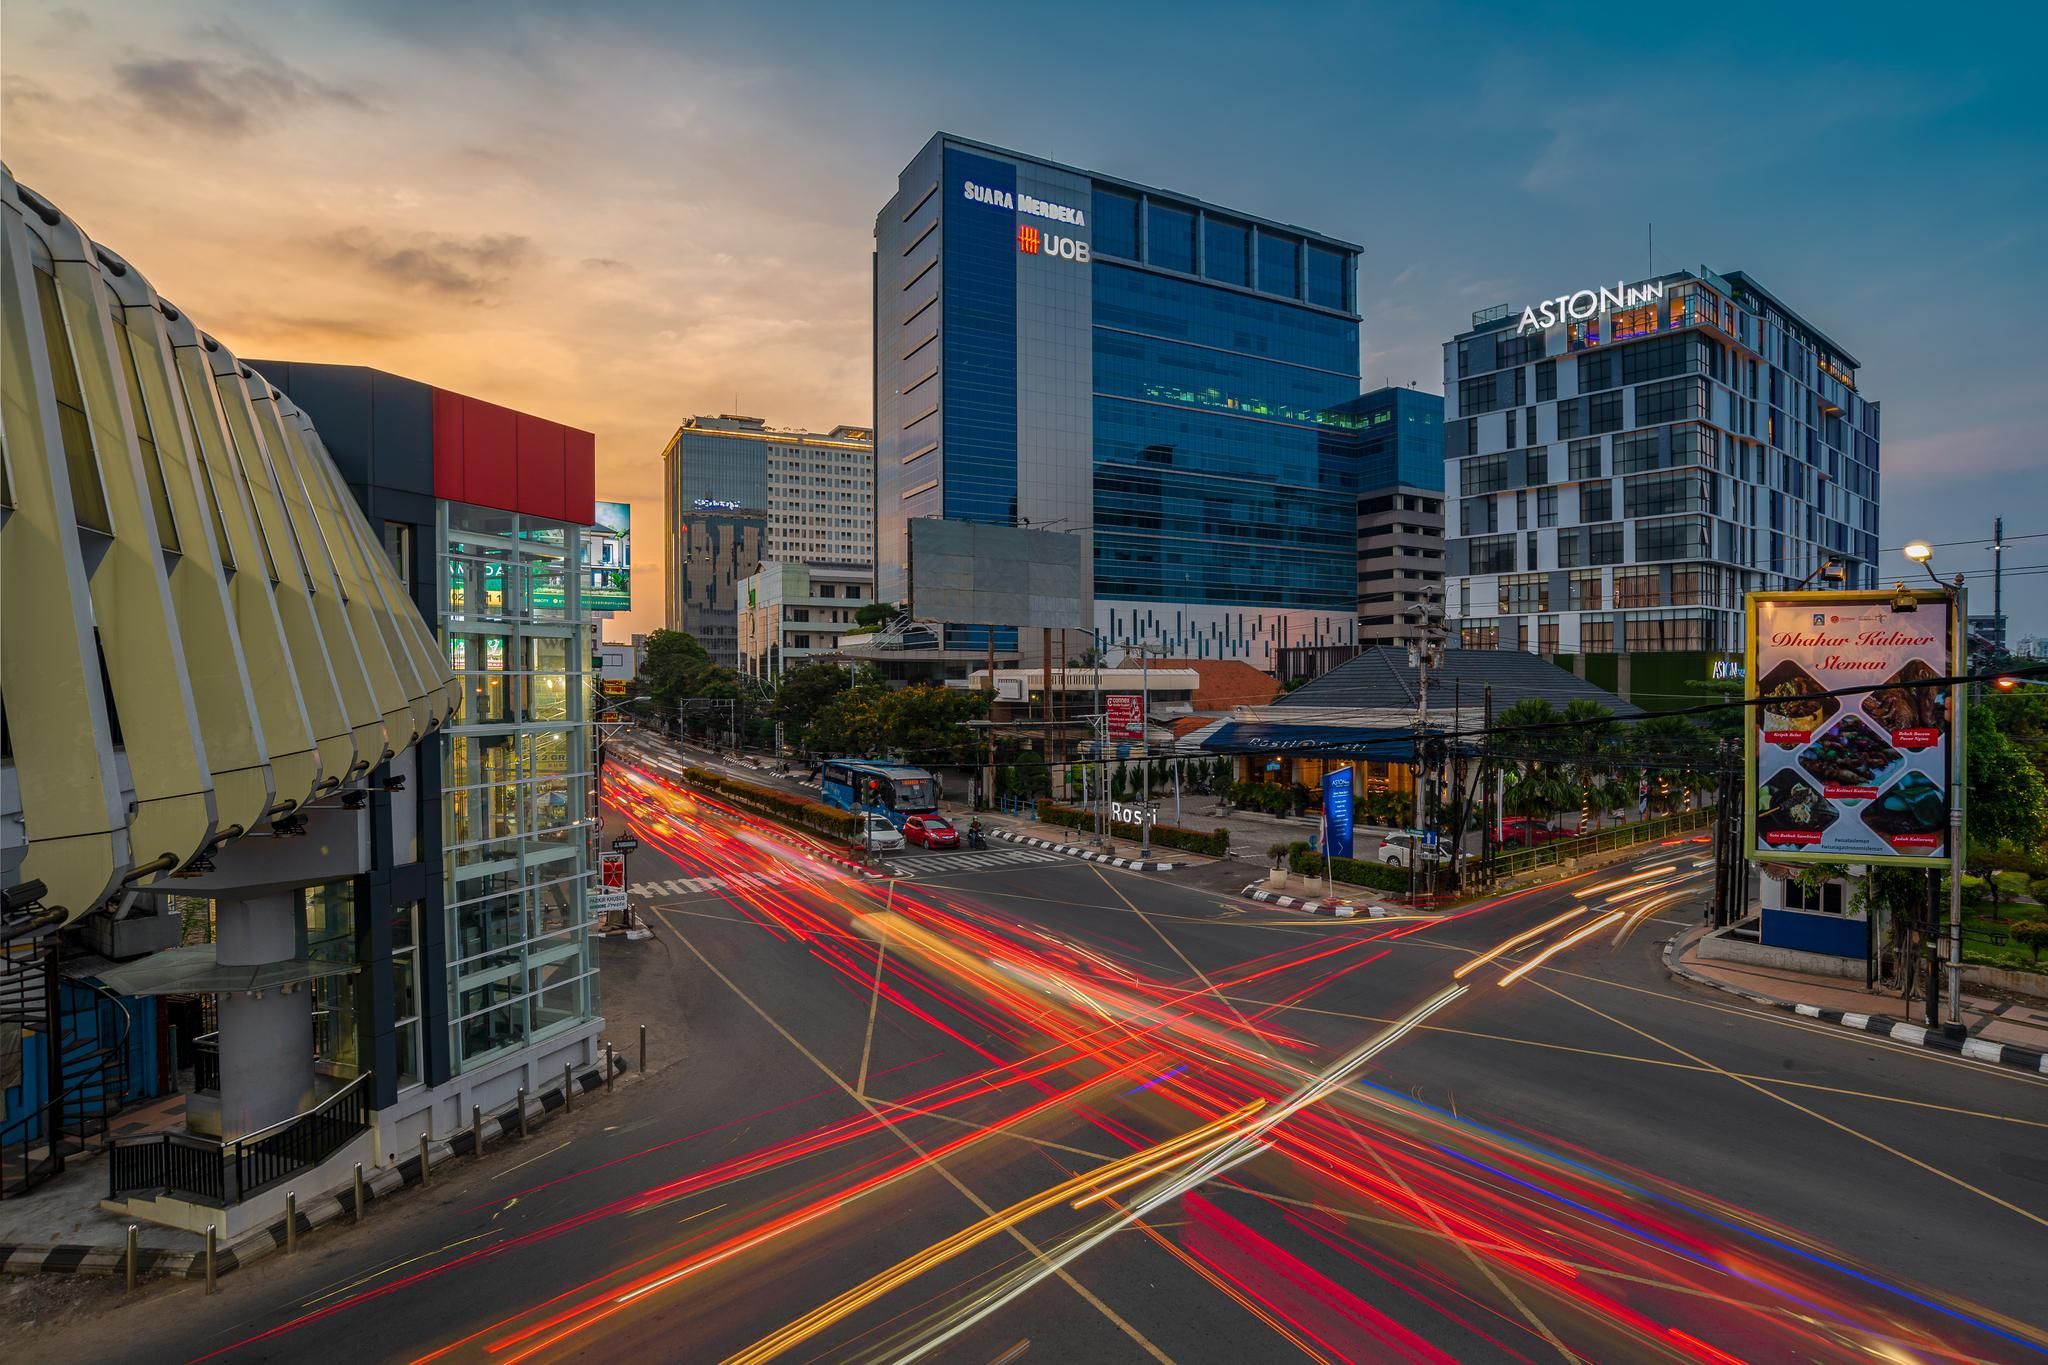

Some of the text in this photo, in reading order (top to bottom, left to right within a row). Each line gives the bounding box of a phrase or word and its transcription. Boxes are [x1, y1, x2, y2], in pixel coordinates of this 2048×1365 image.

[964, 181, 1085, 226] SUARA MERDEKA
[1044, 233, 1090, 263] UOB
[1516, 280, 1663, 334] ASTON INN
[1771, 631, 1936, 647] Dhahar Kuliner
[1815, 655, 1887, 670] Sleman
[1111, 801, 1157, 828] Rosi
